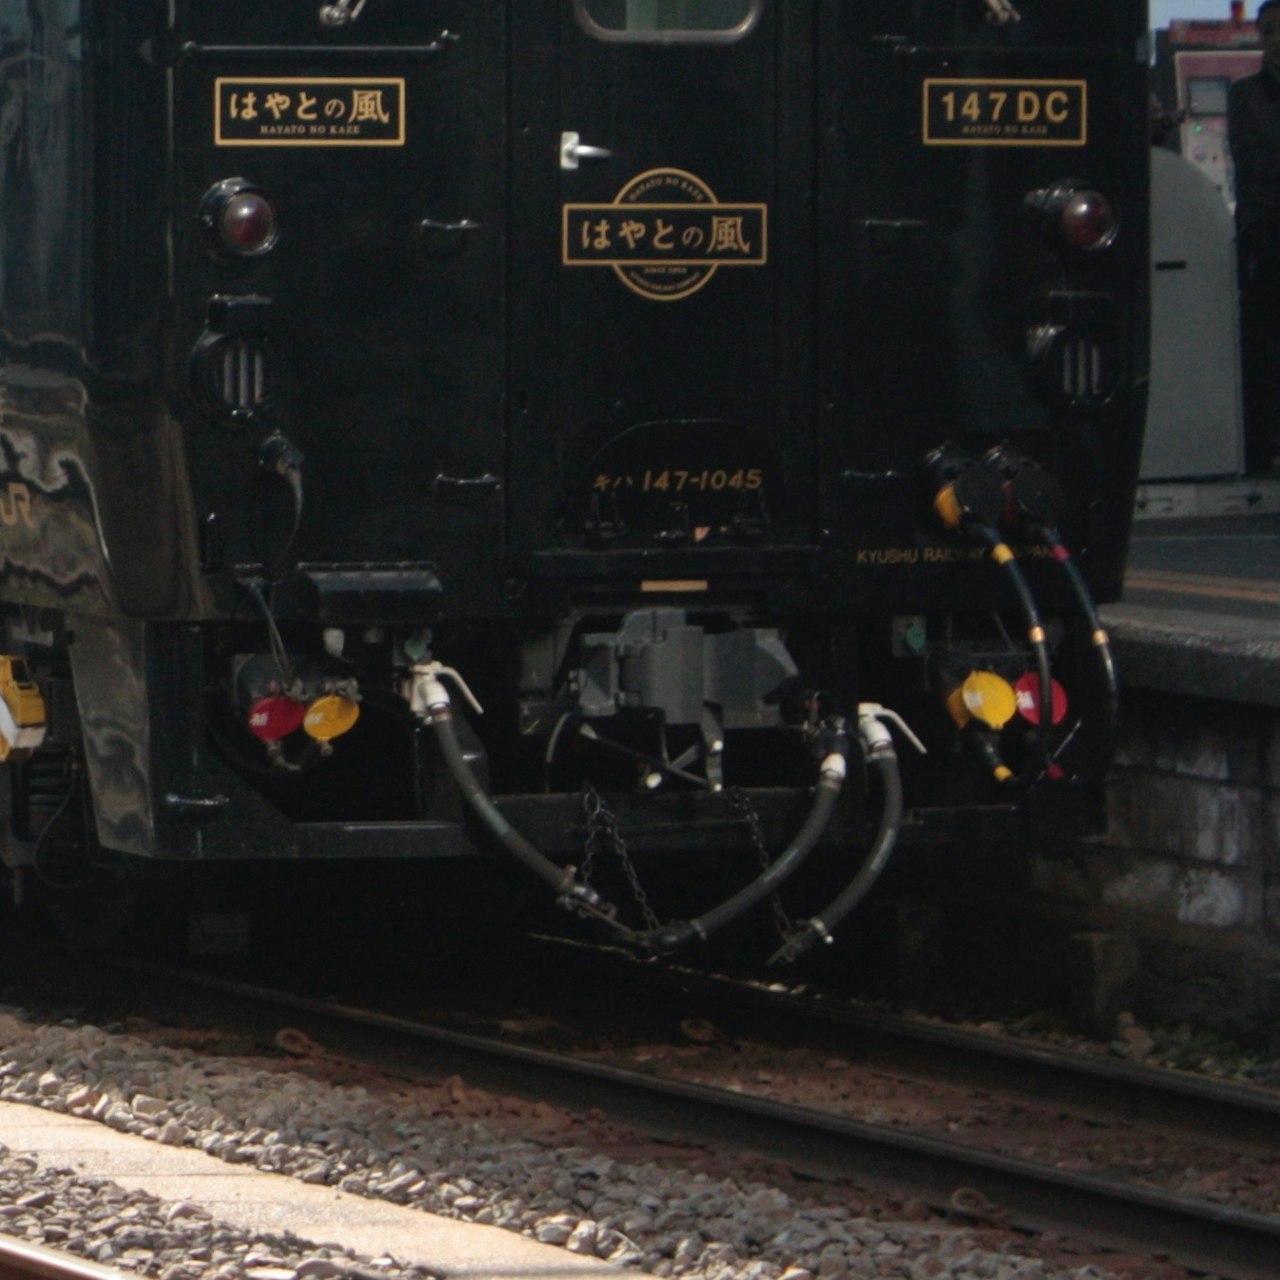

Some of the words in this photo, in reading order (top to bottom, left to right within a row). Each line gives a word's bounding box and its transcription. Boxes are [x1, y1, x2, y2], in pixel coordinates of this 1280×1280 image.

[229, 88, 390, 124] はやとの風
[260, 125, 306, 134] HAYATO
[309, 125, 326, 134] NO
[329, 125, 360, 134] KAZE
[580, 216, 751, 254] はやとの風
[593, 473, 634, 491] キハ
[642, 468, 763, 492] 147-1045
[856, 547, 919, 564] KYUSHU
